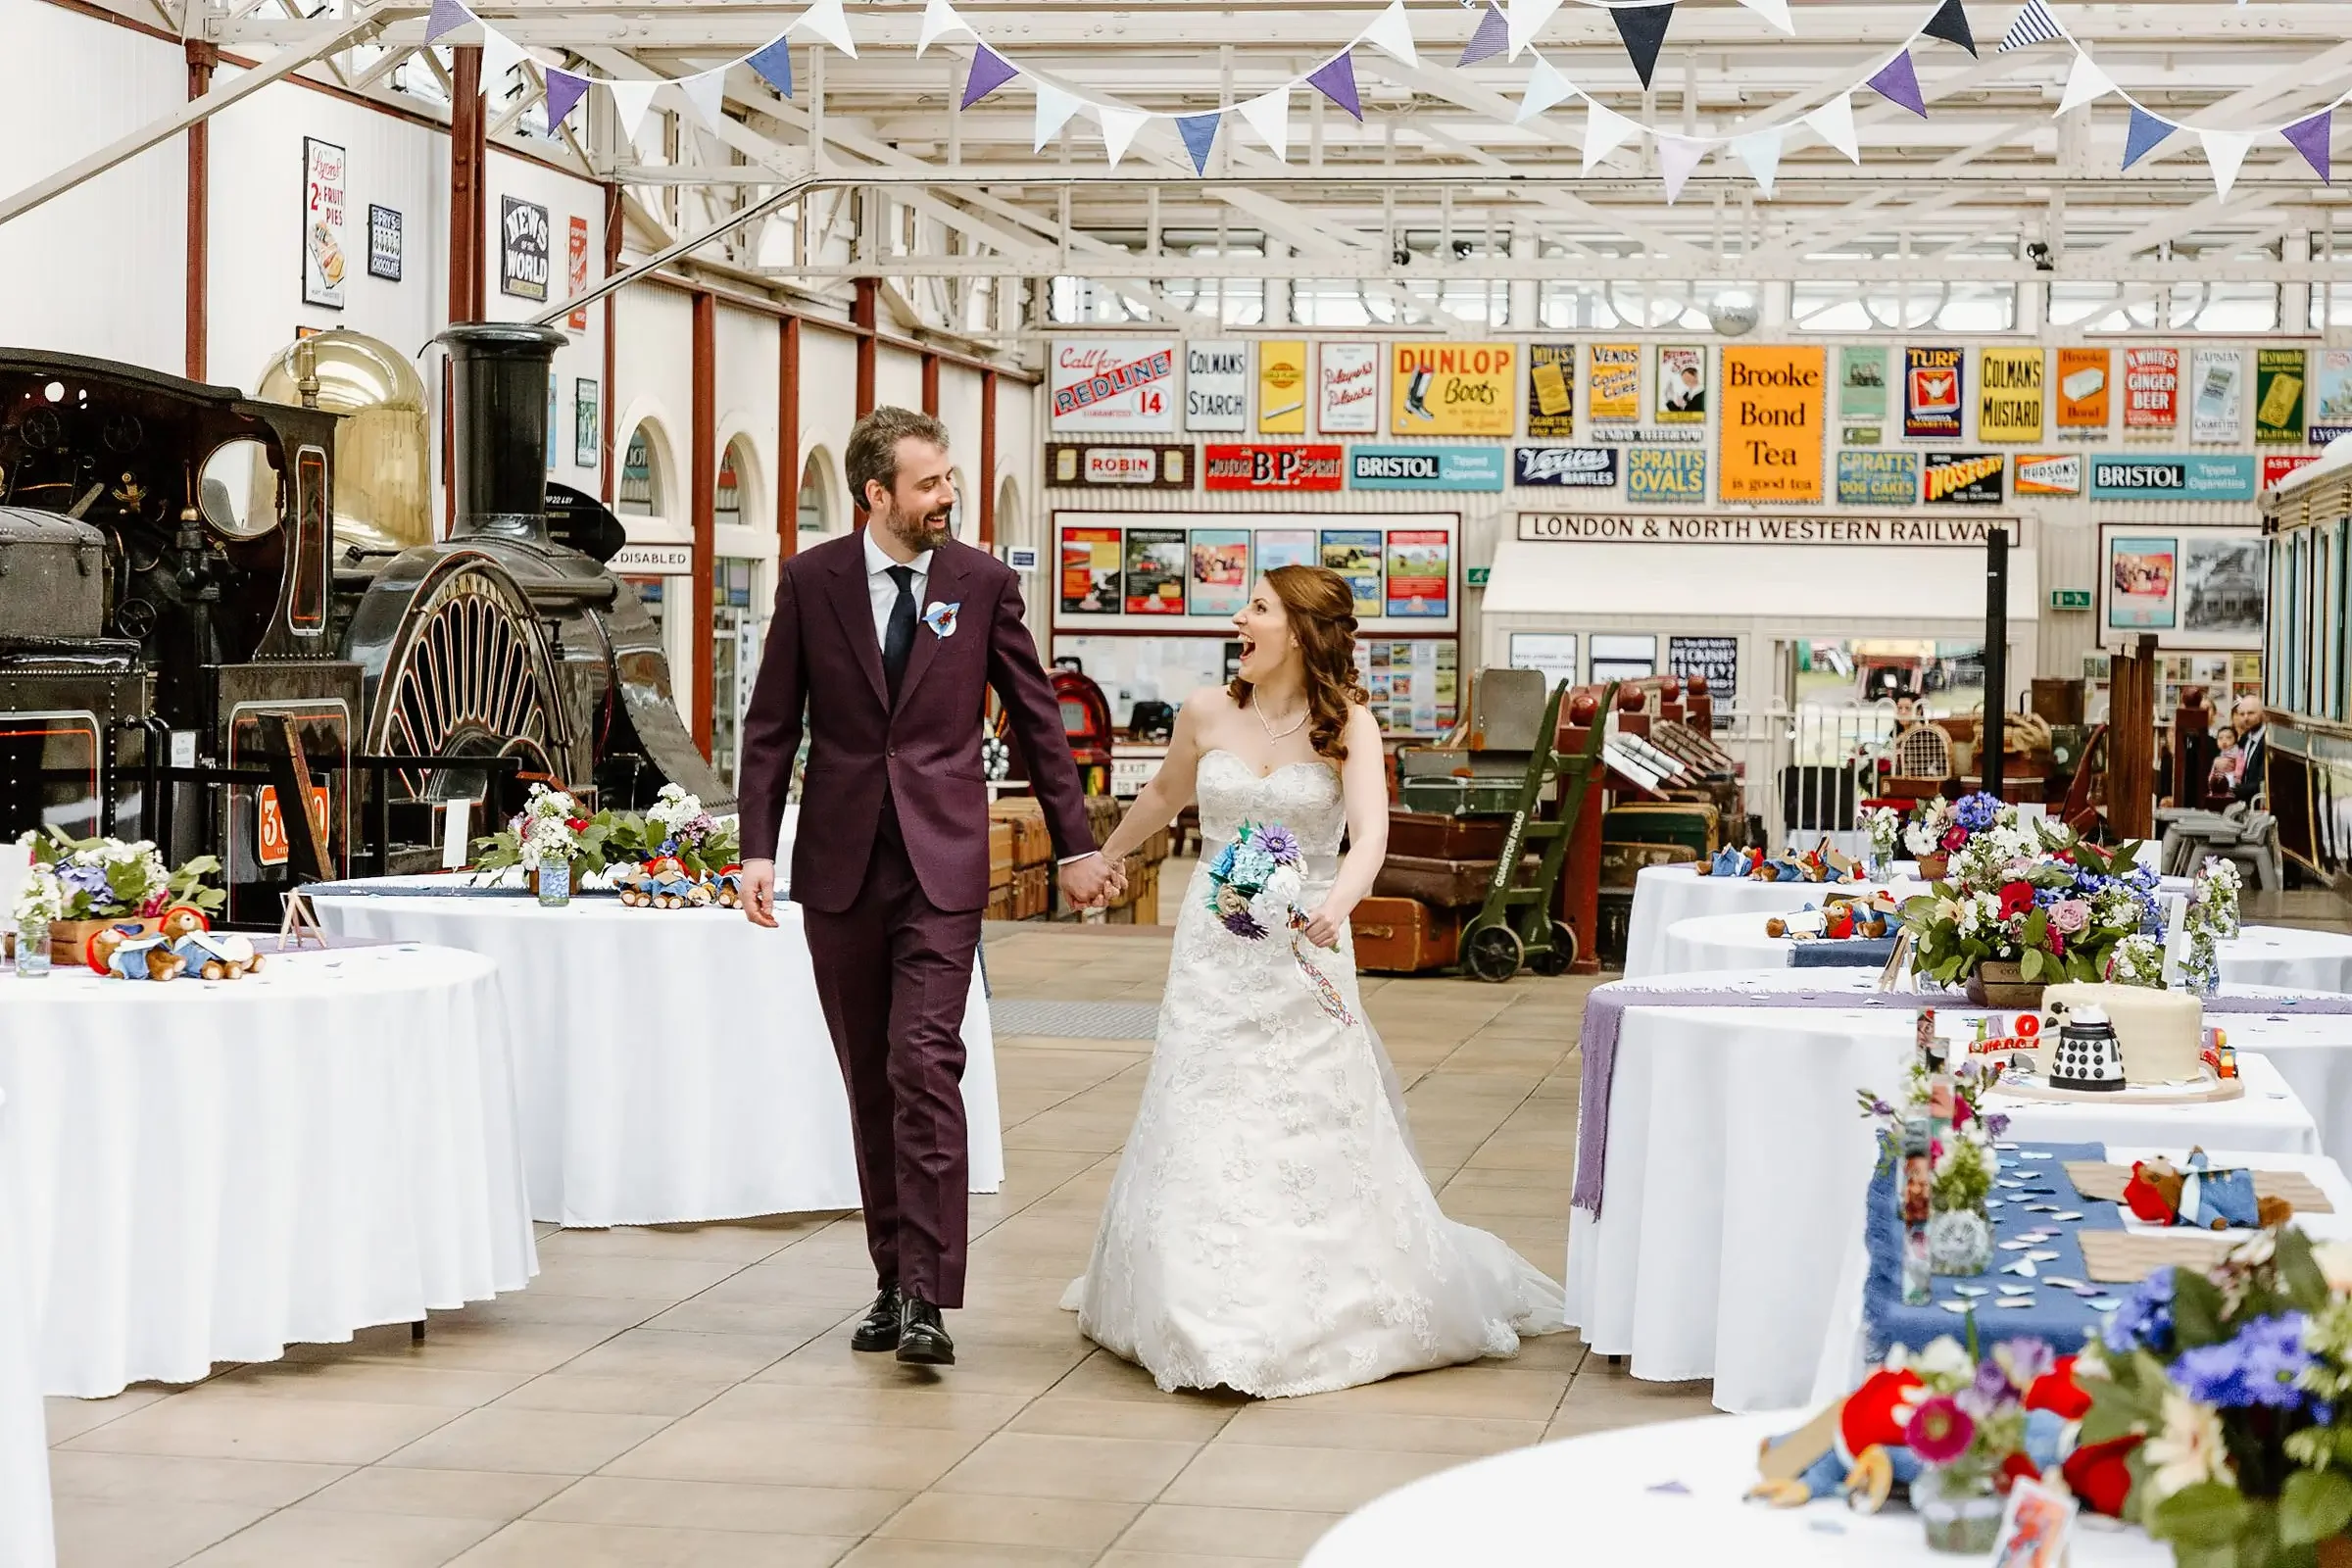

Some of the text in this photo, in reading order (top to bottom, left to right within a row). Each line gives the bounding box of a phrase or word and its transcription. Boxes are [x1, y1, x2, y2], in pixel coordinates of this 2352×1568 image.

[324, 185, 343, 206] FRUIT
[326, 208, 343, 225] PIES
[507, 205, 548, 252] NEWS
[508, 249, 548, 284] WORLD
[1060, 347, 1121, 376] Call for
[1398, 349, 1510, 374] DUNLOP
[1907, 349, 1961, 368] TURF
[1056, 353, 1169, 411] REDLINE
[1731, 360, 1818, 386] Brooke
[2129, 372, 2176, 391] GINGER
[1141, 391, 1161, 414] 14
[1189, 390, 1243, 416] STARCH
[1444, 376, 1498, 406] Boots
[2132, 391, 2170, 410] BEER
[1740, 401, 1805, 425] Bond
[1983, 396, 2039, 427] MUSTARD
[1092, 459, 1149, 470] ROBIN
[1517, 449, 1610, 479] Veritas
[1745, 440, 1796, 466] Tea
[1356, 456, 1438, 477] BRISTOL
[1927, 455, 2004, 501] NOSEGAY
[2098, 466, 2182, 487] BRISTOL
[1631, 469, 1702, 491] OVALS
[1733, 477, 1812, 491] is good tea
[1534, 517, 1633, 536] LONDON
[1642, 518, 1659, 537] &
[1669, 519, 1750, 538] NORTH
[1760, 520, 1881, 540] WESTERN
[620, 553, 686, 564] DISABLED
[1509, 809, 1525, 839] ROAD
